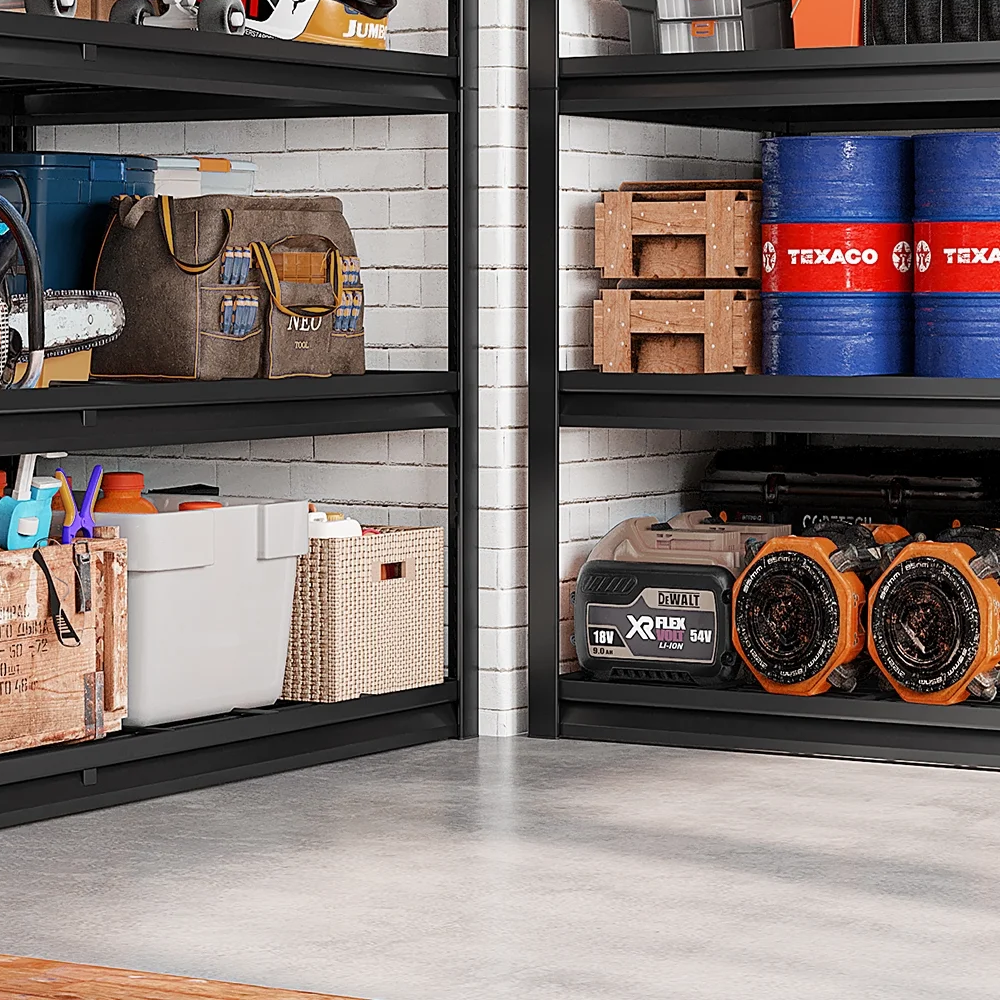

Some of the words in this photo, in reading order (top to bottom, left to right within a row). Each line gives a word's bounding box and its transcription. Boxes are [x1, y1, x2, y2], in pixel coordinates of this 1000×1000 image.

[342, 19, 388, 40] JUMB
[788, 249, 879, 265] TEXACO
[287, 315, 323, 331] NEO
[625, 614, 656, 640] XR
[655, 616, 687, 630] FLEX
[593, 630, 614, 644] 18V
[656, 629, 685, 642] VOLT
[689, 629, 712, 643] 54V
[592, 647, 605, 655] 9.0
[658, 642, 684, 650] LI-ION
